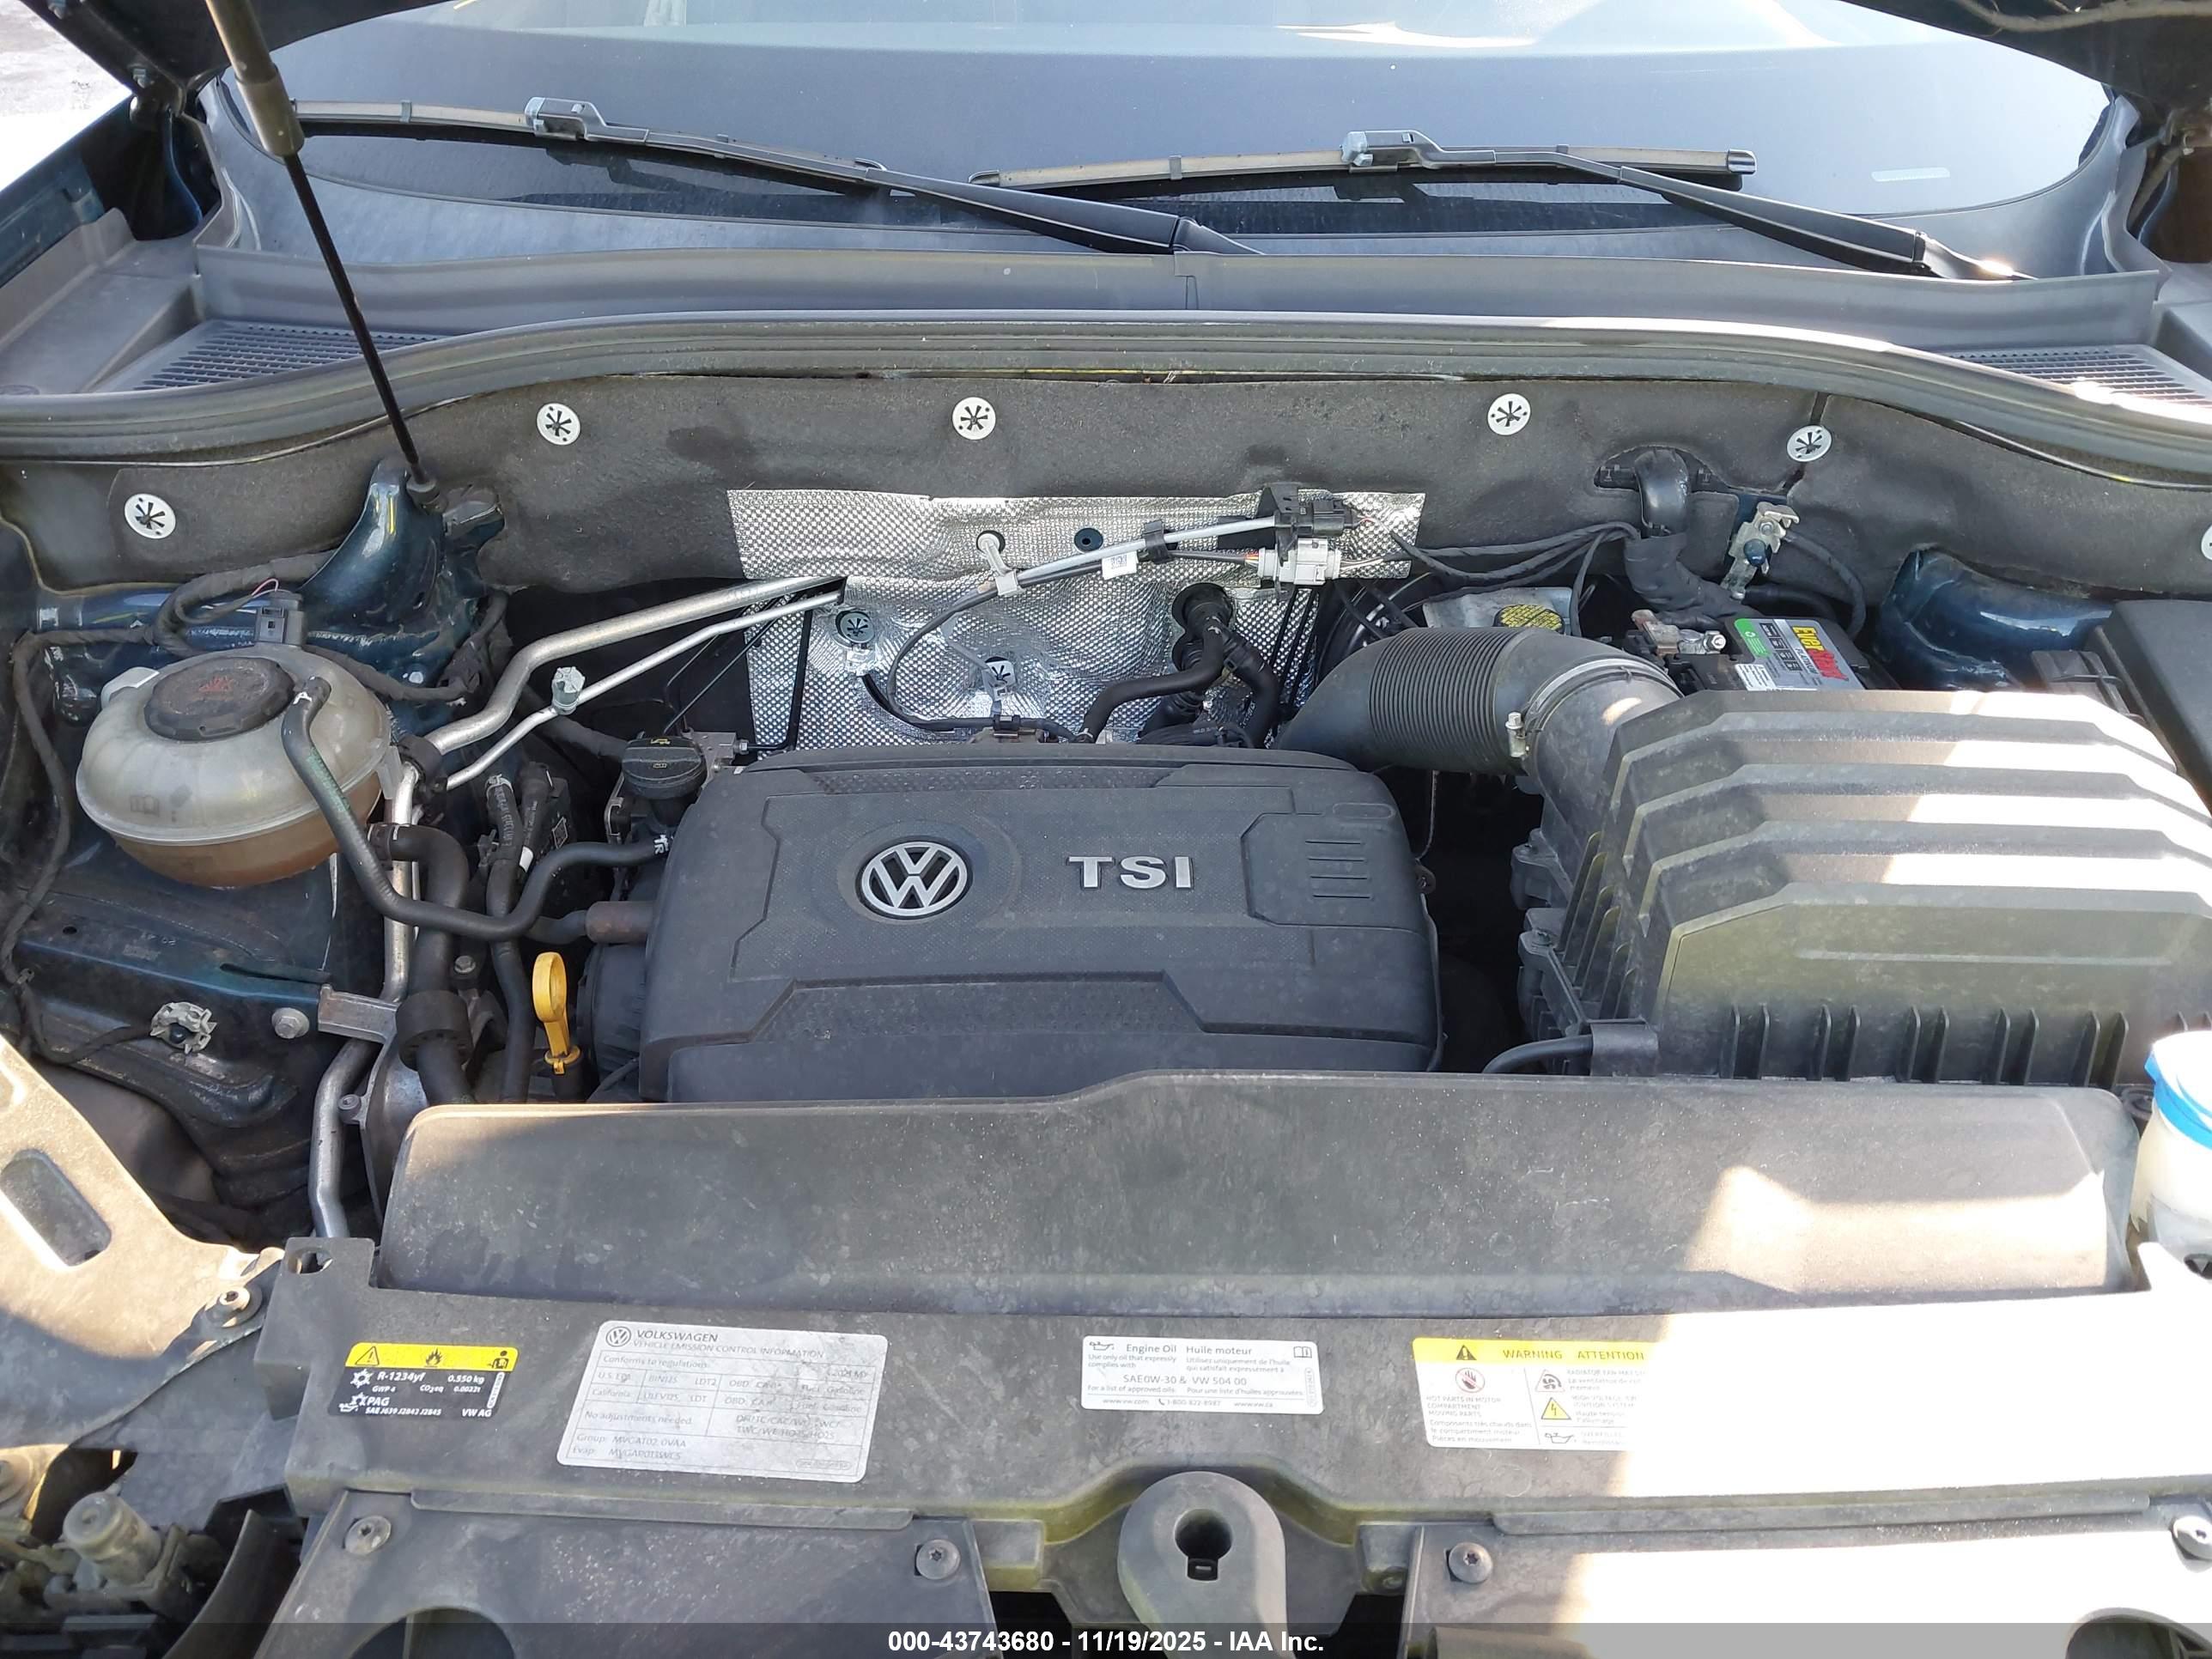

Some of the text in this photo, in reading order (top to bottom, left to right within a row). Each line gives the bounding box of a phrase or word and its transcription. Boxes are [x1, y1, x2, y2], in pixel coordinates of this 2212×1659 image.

[1069, 856, 1194, 890] TSI
[862, 842, 967, 916] VW
[637, 1330, 719, 1343] VOLKSWAGEN
[634, 1340, 824, 1358] VEHICLE EMISSION CONTROL INFORMATION
[1126, 1344, 1160, 1354] Engine
[604, 1355, 644, 1365] Conforms
[1503, 1350, 1562, 1360] WARNING
[1577, 1351, 1644, 1361] ATTENTION
[377, 1372, 426, 1383] R-1234yf
[447, 1375, 485, 1385] 0.550 kg
[695, 1377, 716, 1386] LDT2
[1234, 1377, 1248, 1386] 00
[367, 1397, 390, 1407] PAG
[585, 1411, 599, 1419] No
[600, 1413, 656, 1424] adjustments
